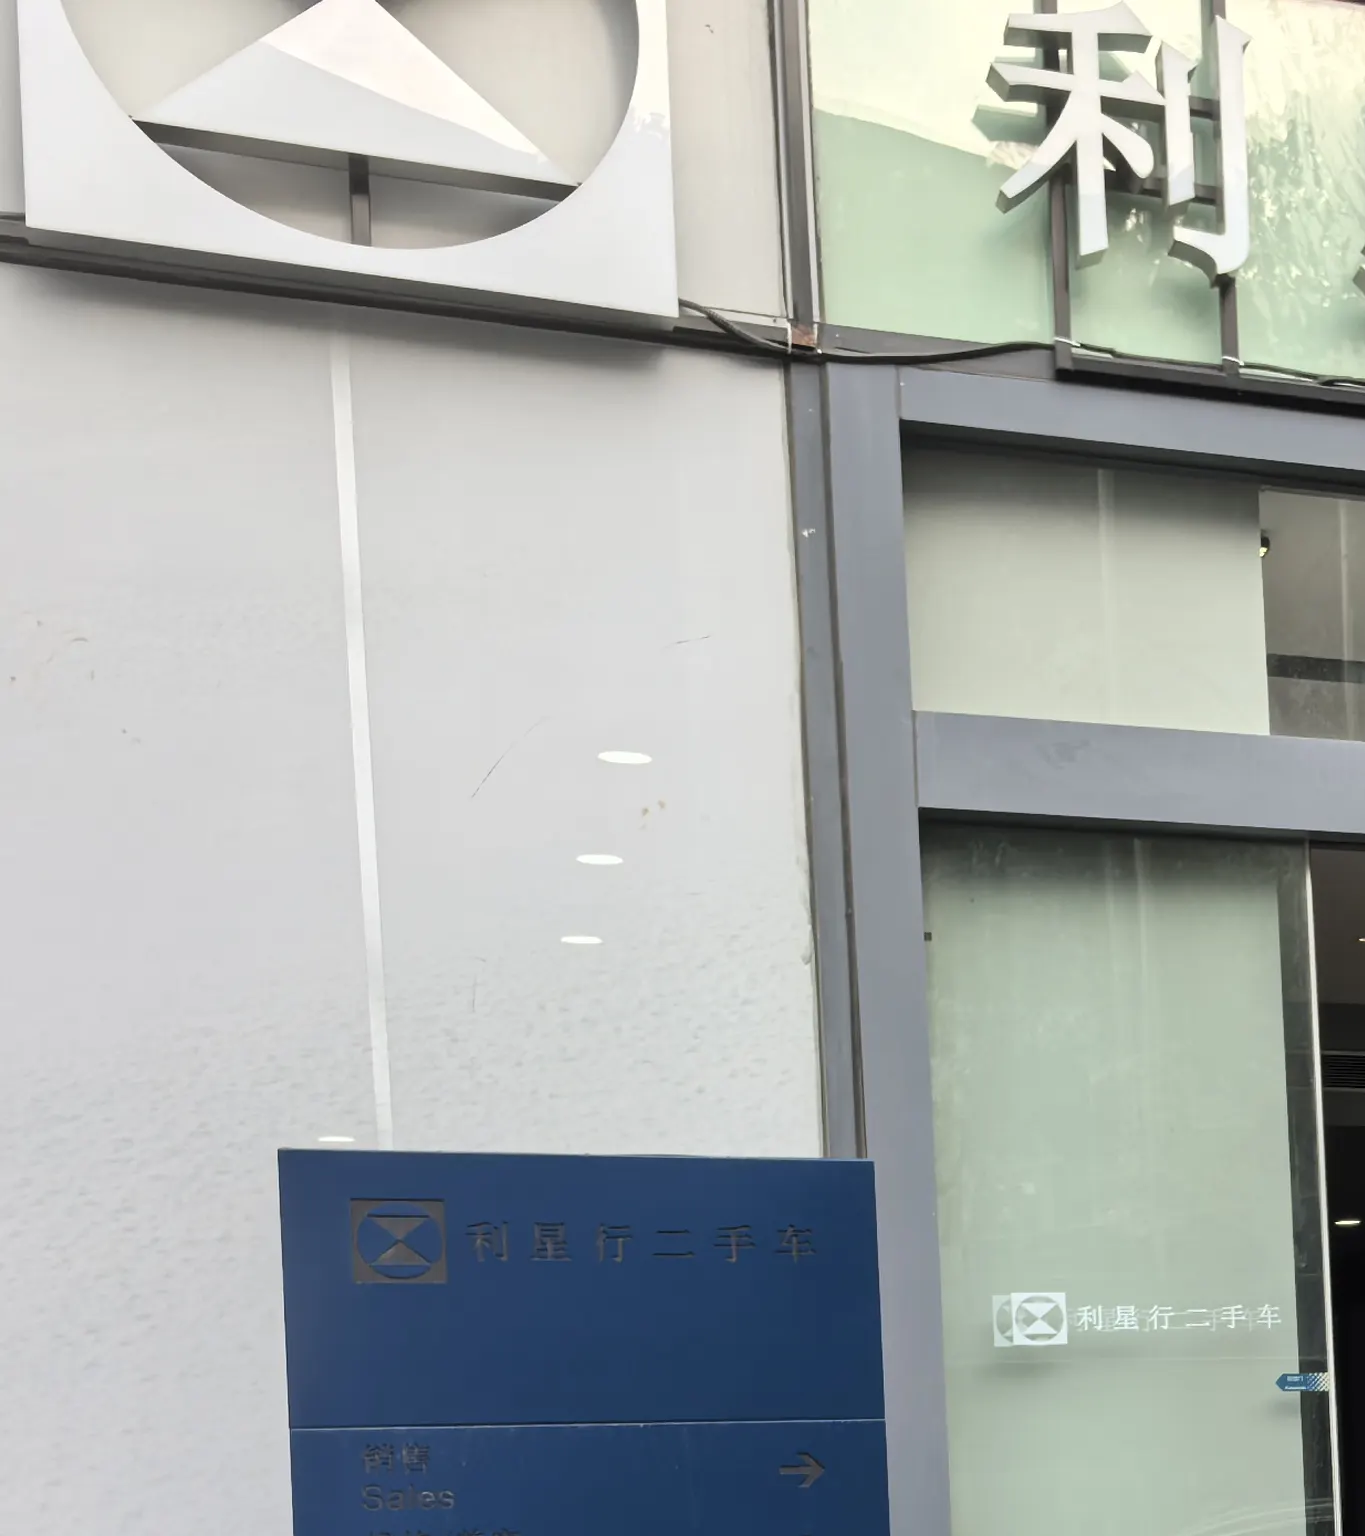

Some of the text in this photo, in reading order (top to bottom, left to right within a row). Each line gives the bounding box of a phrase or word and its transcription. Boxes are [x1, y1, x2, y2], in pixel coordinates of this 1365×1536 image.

[466, 1220, 818, 1264] 利星行二手车
[1075, 1303, 1282, 1331] 利星行二手车
[362, 1442, 432, 1474] 销售
[361, 1484, 455, 1512] Sales
